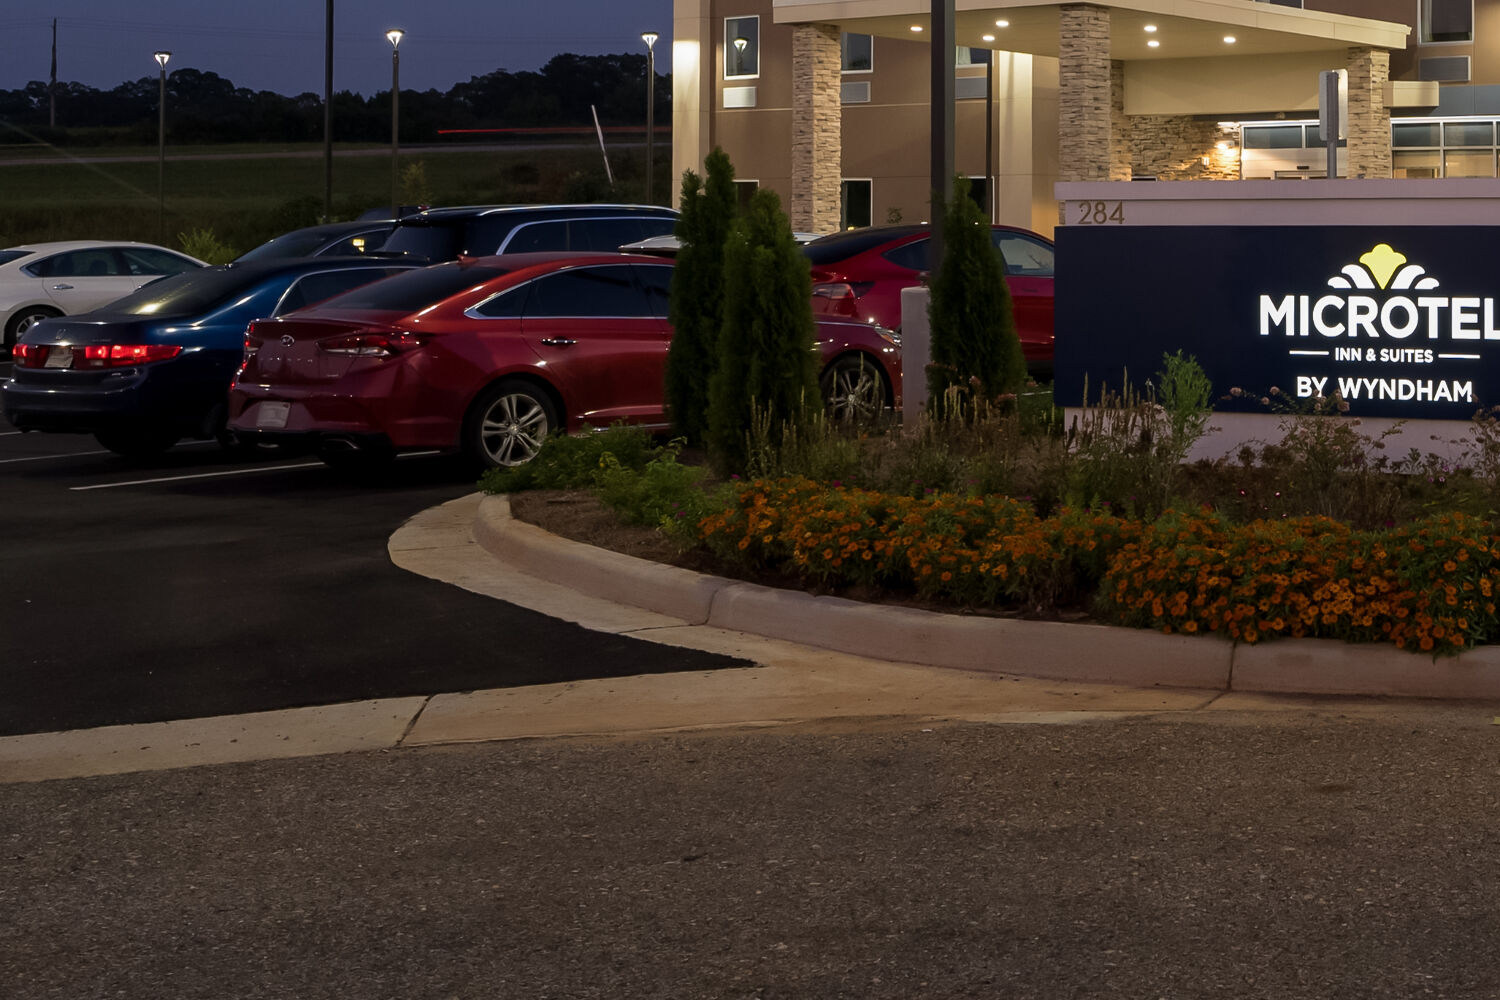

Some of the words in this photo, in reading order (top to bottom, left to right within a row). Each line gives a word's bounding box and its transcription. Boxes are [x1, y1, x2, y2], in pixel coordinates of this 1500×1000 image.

[1078, 200, 1126, 225] 284
[1335, 347, 1362, 362] INN
[1365, 348, 1377, 362] &
[1379, 348, 1434, 364] SUITES
[1296, 376, 1328, 399] BY
[1337, 377, 1473, 403] WYNDHAM
